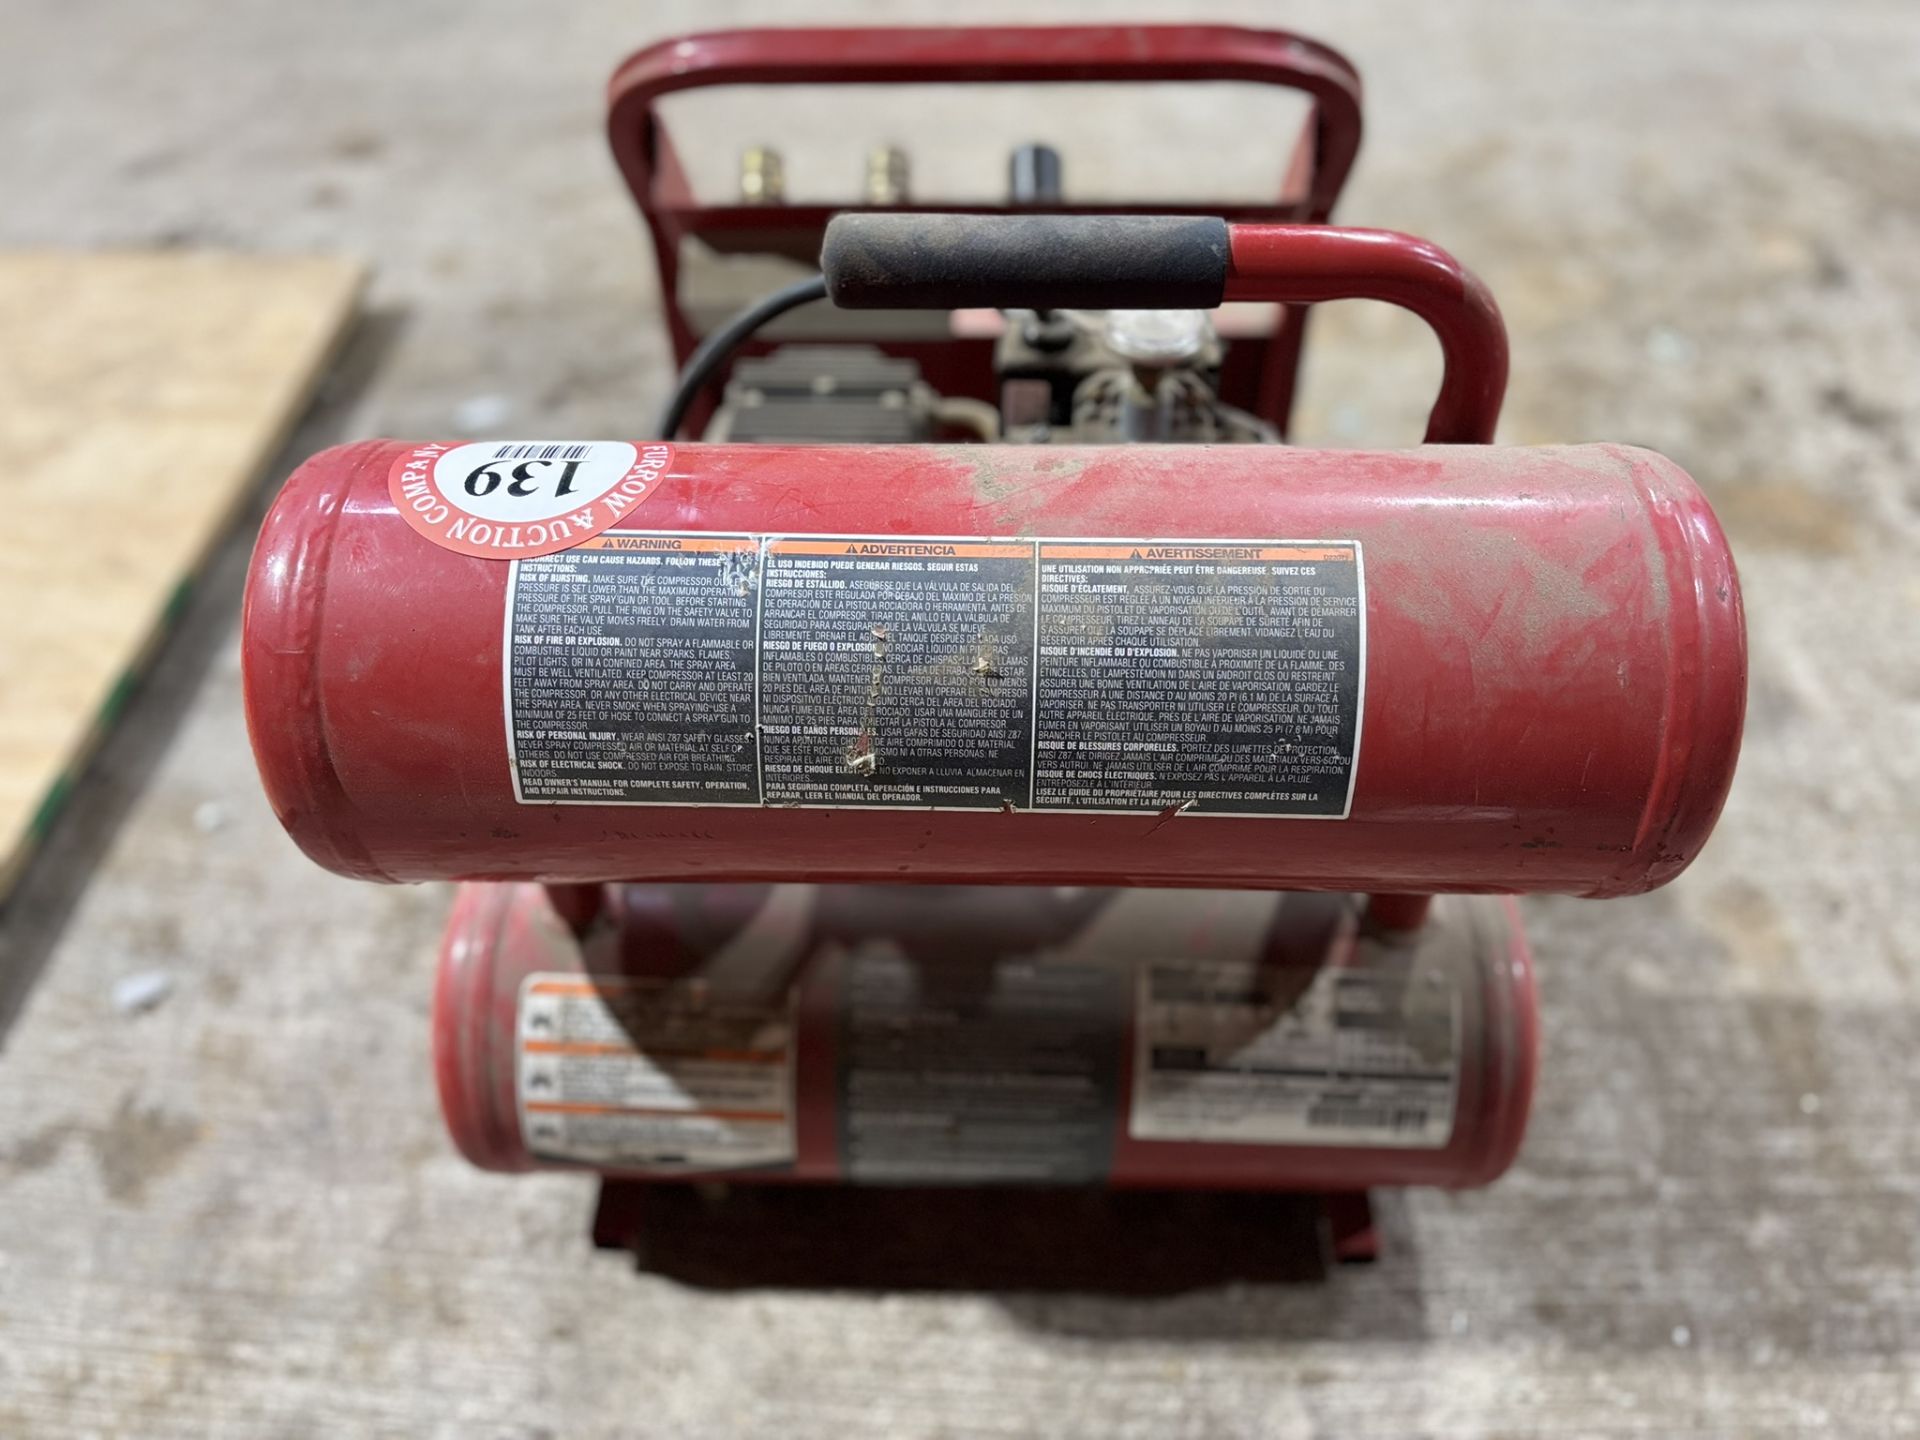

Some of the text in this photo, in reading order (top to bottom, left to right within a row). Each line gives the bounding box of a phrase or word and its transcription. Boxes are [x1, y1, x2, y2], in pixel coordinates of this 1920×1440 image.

[464, 460, 592, 497] 139
[400, 444, 668, 548] FURROW AUCTION COMPANY
[617, 539, 681, 549] WARNING
[860, 545, 955, 556] ADVERTENCIA
[566, 554, 579, 563] USE
[582, 555, 597, 564] CAN
[600, 555, 623, 564] CAUSE
[665, 557, 695, 566] FOLLOW
[698, 557, 720, 566] THESE
[1146, 548, 1262, 560] AVERTISSEMENT
[520, 564, 576, 573] INSTRUCTIONS:
[767, 559, 978, 572] EL USO INDEBIDO PUEDE GENERAR RIESGOS. SEGUIR ESTAS
[1041, 563, 1056, 573] UNE
[1058, 563, 1103, 573] UTILISATION
[1106, 564, 1121, 574] NON
[1174, 565, 1192, 575] PEUT
[1271, 566, 1298, 577] SUIVEZ
[1301, 567, 1314, 577] CES
[766, 569, 826, 579] INSTRUCCIONES:
[1041, 573, 1087, 582] DIRECTIVES:
[766, 579, 792, 588] RIESGO
[794, 580, 803, 588] DE
[806, 580, 846, 589] ESTALLIDO.
[896, 582, 910, 590] QUE
[912, 582, 921, 591] LA
[960, 583, 969, 592] DE
[972, 583, 998, 592] SALIDA
[1000, 584, 1014, 592] DEL
[1041, 583, 1068, 592] RISQUE
[1197, 585, 1212, 594] QUE
[1215, 586, 1225, 594] LA
[1270, 586, 1280, 595] DE
[1282, 587, 1310, 596] SORTIE
[1313, 587, 1324, 596] DU
[516, 603, 530, 612] THE
[592, 605, 612, 614] PULL
[615, 605, 629, 614] THE
[632, 605, 651, 615] RING
[654, 606, 664, 615] ON
[667, 606, 681, 616] THE
[684, 607, 712, 616] SAFETY
[715, 607, 739, 617] VALVE
[742, 608, 752, 617] TO
[764, 609, 805, 619] ARRANCAR
[808, 610, 816, 619] EL
[871, 611, 892, 620] TIRAR
[895, 612, 908, 621] DEL
[941, 612, 950, 622] EN
[952, 613, 961, 622] LA
[1000, 614, 1009, 623] DE
[514, 624, 534, 633] TANK
[537, 624, 561, 634] AFTER
[564, 625, 584, 634] EACH
[514, 635, 753, 649] RISK OF FIRE OR EXPLOSION. DO NOT SPRAY A FLAMMABLE OR
[1040, 646, 1067, 655] RISQUE
[1114, 647, 1124, 656] OU
[1182, 648, 1191, 657] NE
[1194, 648, 1209, 657] PAS
[1212, 649, 1257, 658] VAPORISER
[1260, 649, 1271, 658] UN
[1274, 650, 1305, 659] LIQUIDE
[1308, 650, 1319, 659] OU
[1322, 650, 1338, 659] UNE
[519, 759, 536, 767] RISK
[539, 759, 548, 768] OF
[551, 760, 595, 769] ELECTRICAL
[598, 761, 625, 769] SHOCK.
[628, 761, 638, 770] DO
[641, 762, 656, 770] NOT
[659, 762, 688, 771] EXPOSE
[691, 763, 701, 771] TO
[726, 764, 751, 772] STORE
[522, 778, 541, 786] READ
[580, 779, 611, 788] MANUAL
[613, 780, 627, 788] FOR
[630, 780, 669, 789] COMPLETE
[766, 782, 785, 791] PARA
[788, 783, 827, 792] SEGURIDAD
[916, 785, 920, 794] E
[922, 786, 978, 795] INSTRUCCIONES
[981, 787, 1000, 795] PARA
[524, 787, 626, 797] AND REPAIR INSTRUCTIONS.
[805, 792, 822, 800] LEER
[867, 793, 879, 801] DEL
[1036, 787, 1055, 796] LISEZ
[1058, 788, 1066, 796] LE
[1068, 788, 1090, 797] GUIDE
[1092, 788, 1102, 797] DU
[1160, 789, 1180, 798] POUR
[1183, 790, 1196, 798] LES
[1198, 790, 1241, 799] DIRECTIVES
[1291, 791, 1306, 800] SUR
[1308, 792, 1317, 800] LA
[1129, 798, 1137, 806] ET
[1140, 798, 1149, 806] LA
